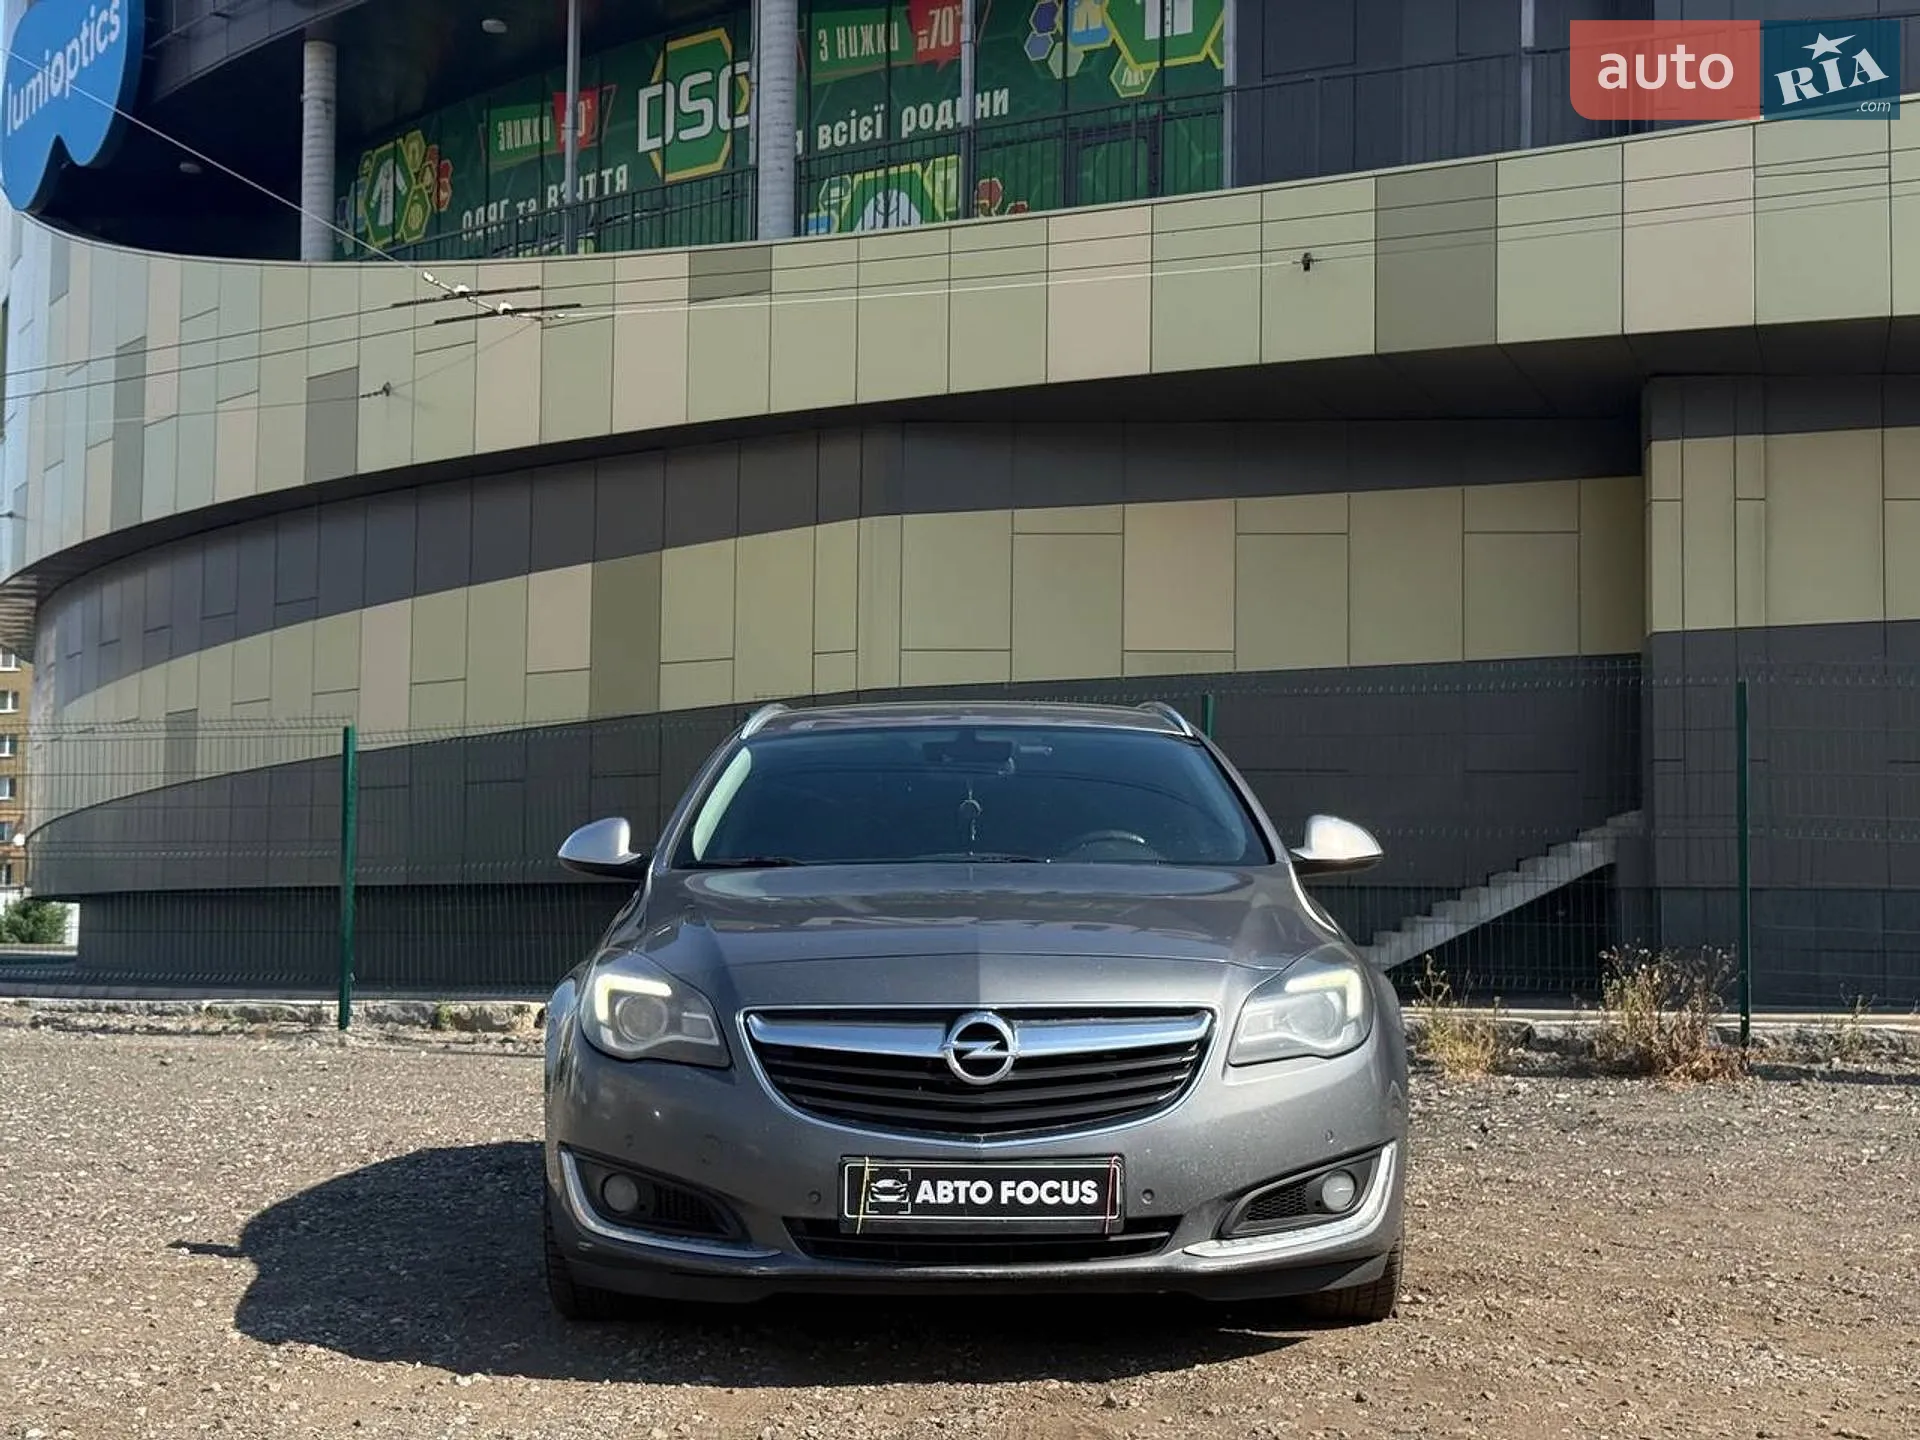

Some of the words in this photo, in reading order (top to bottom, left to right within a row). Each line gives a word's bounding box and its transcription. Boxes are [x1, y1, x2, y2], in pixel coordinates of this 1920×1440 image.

[7, 0, 120, 136] lumioptics
[817, 103, 884, 150] всієї
[1000, 1180, 1098, 1204] FOCUS
